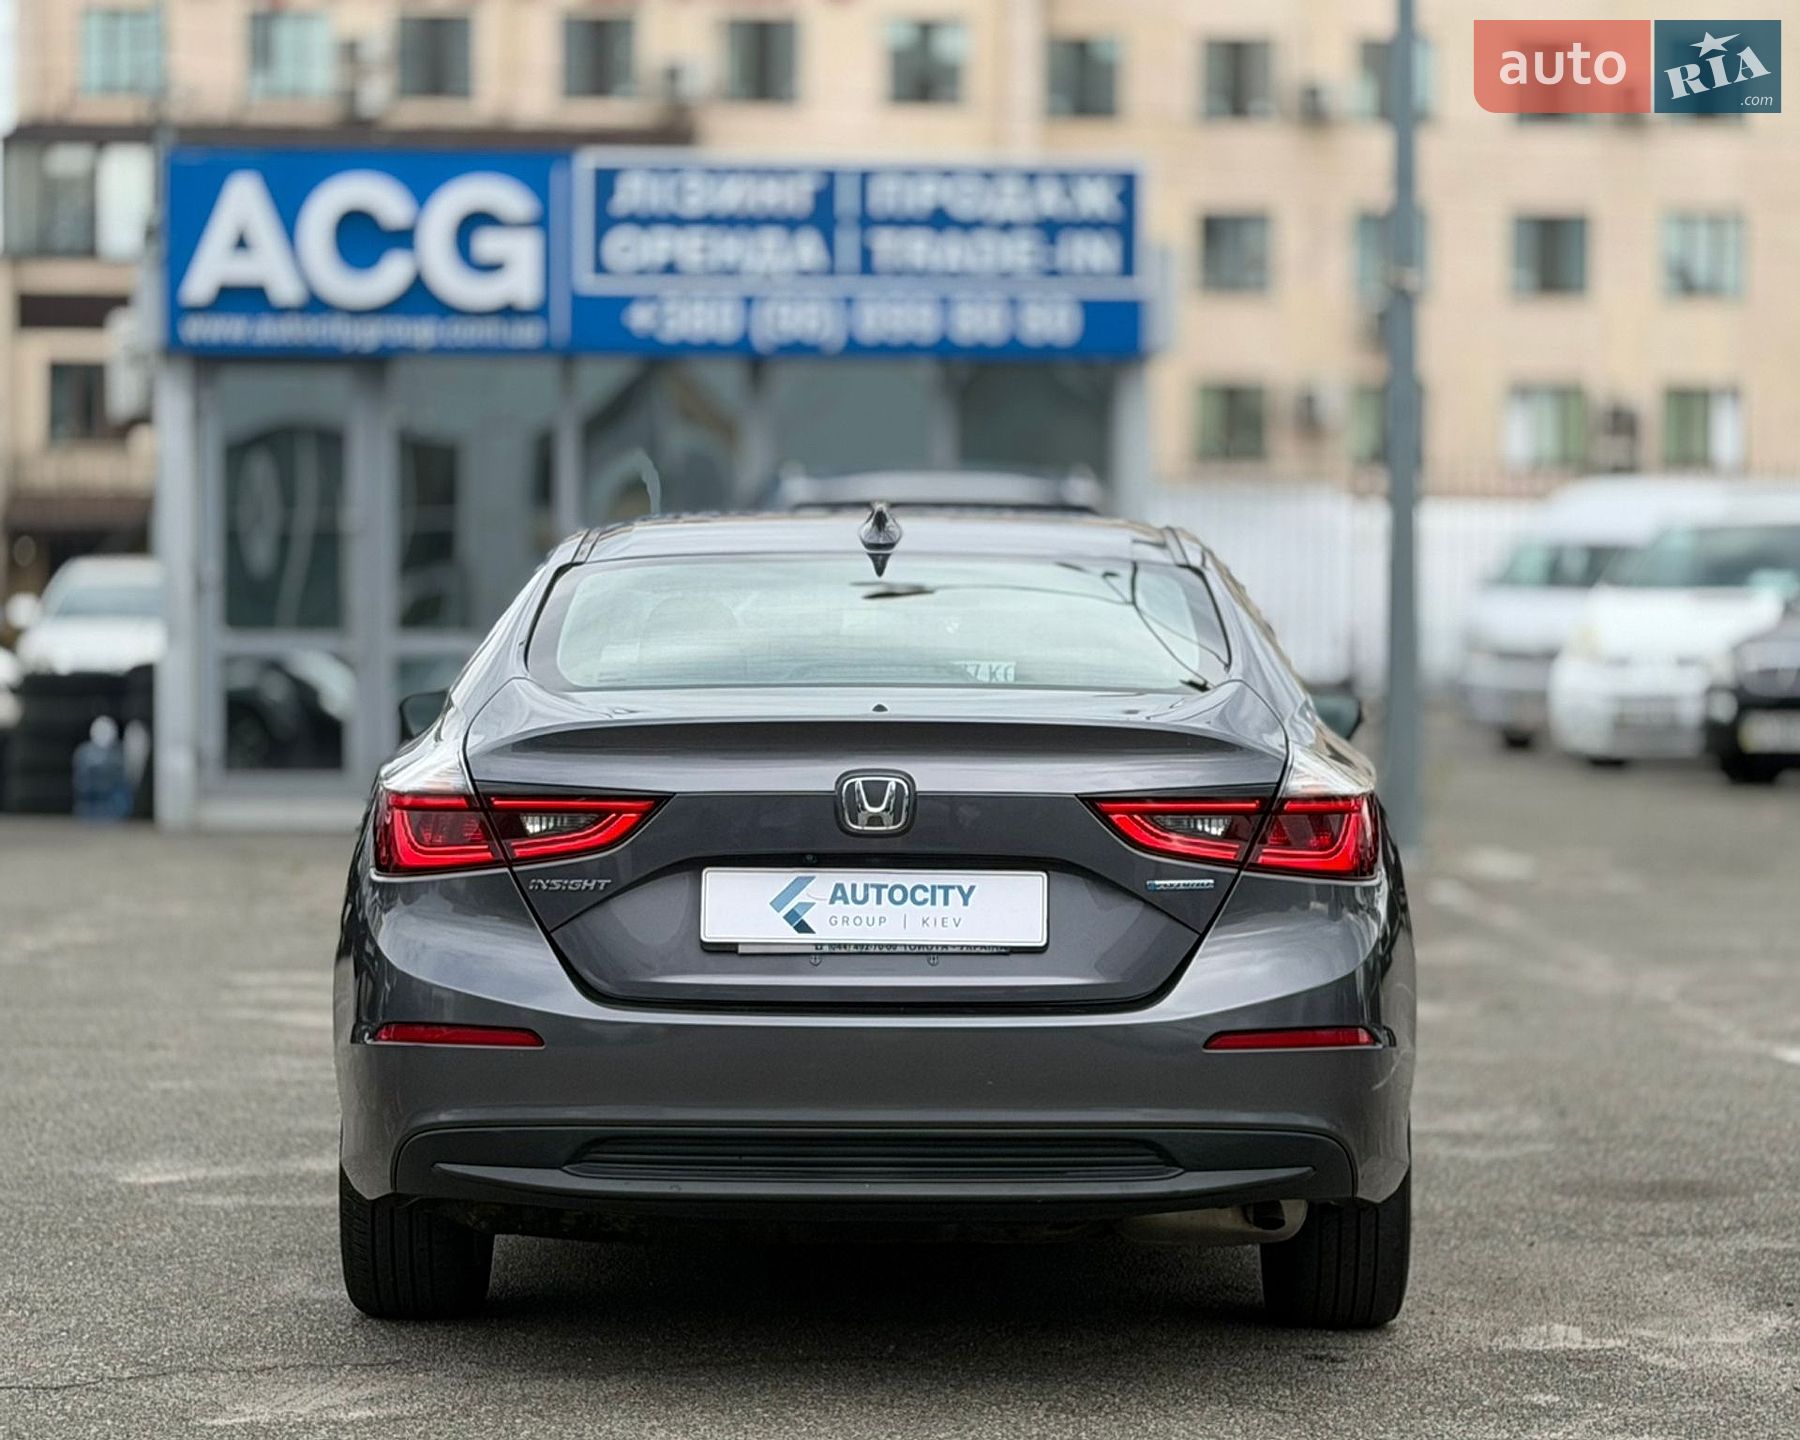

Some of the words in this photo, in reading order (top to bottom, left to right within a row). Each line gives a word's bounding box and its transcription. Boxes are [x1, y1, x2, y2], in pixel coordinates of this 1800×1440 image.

[177, 169, 545, 312] ACG
[602, 225, 830, 279] ОРЕНДА
[867, 227, 1122, 275] TRADE-IN
[528, 879, 612, 891] INSIGHT
[829, 883, 976, 906] AUTOCITY
[829, 915, 887, 927] GROUP
[921, 916, 962, 928] KIEV
